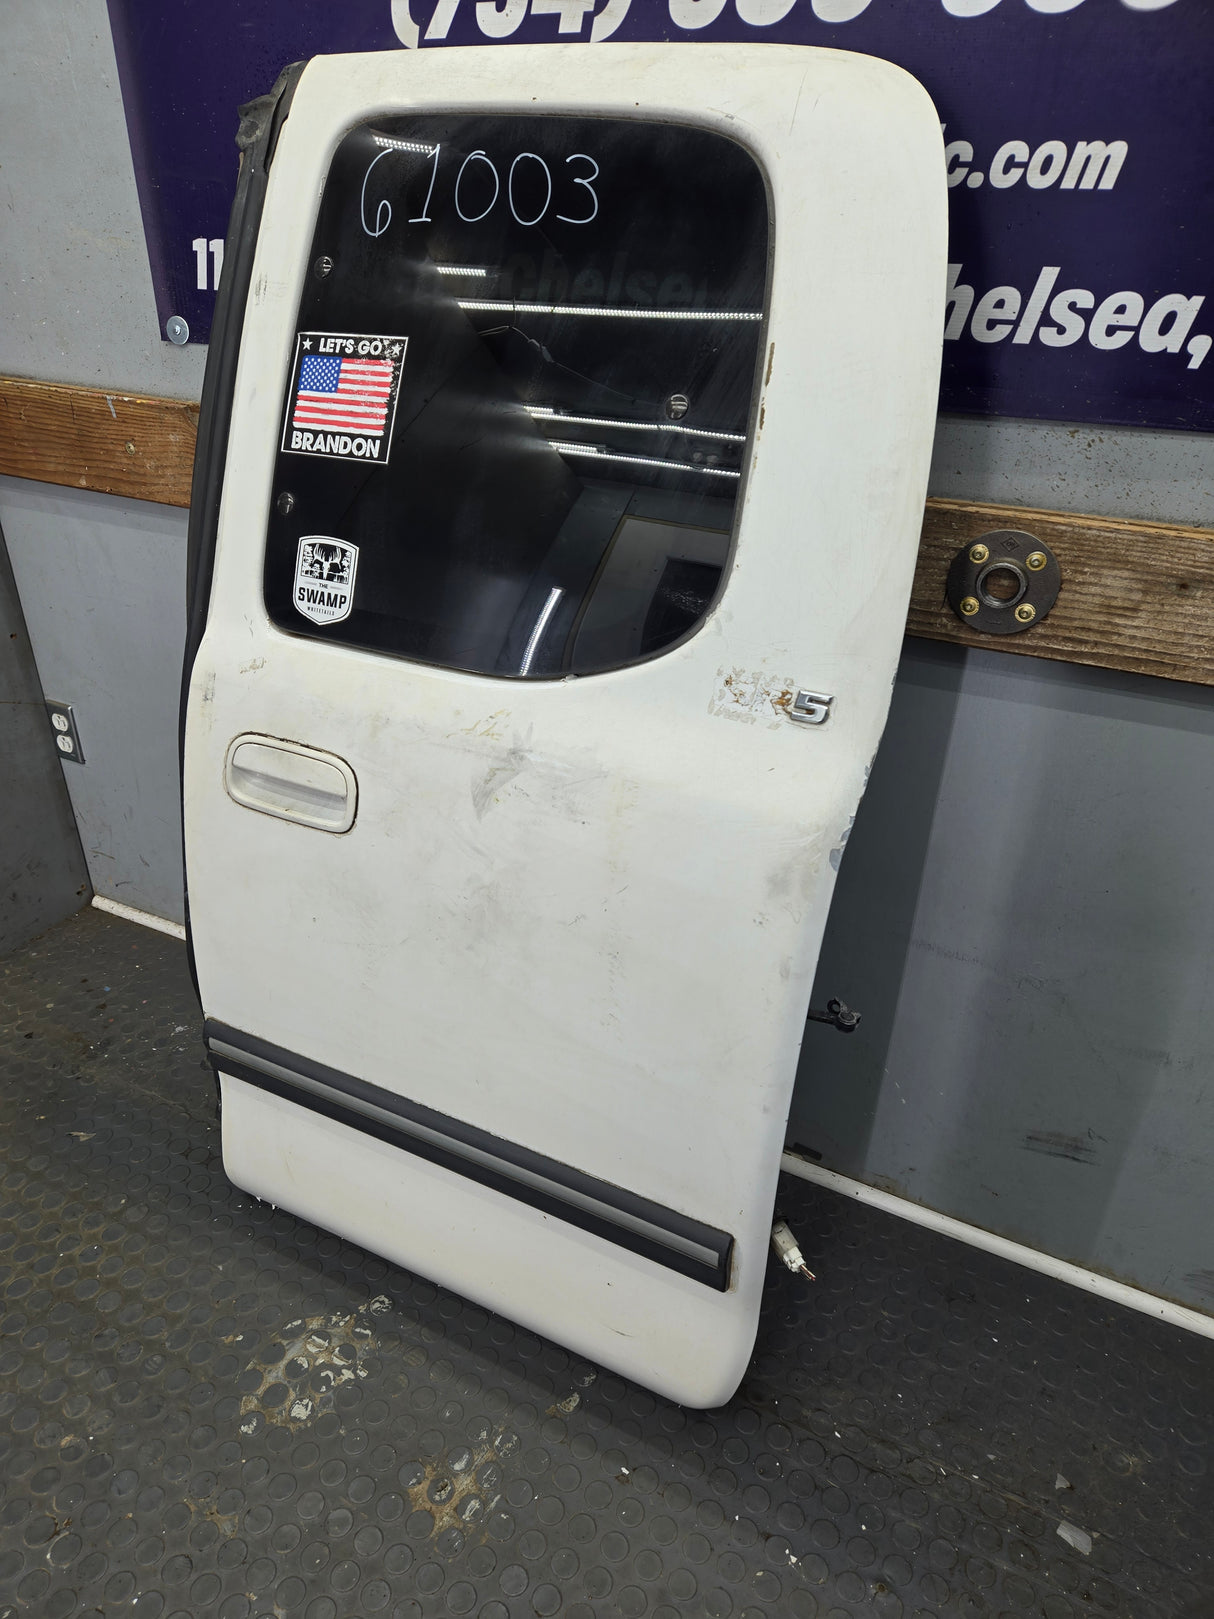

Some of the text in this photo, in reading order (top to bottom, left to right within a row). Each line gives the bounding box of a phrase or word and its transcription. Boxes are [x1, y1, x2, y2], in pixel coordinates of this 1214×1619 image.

[942, 124, 1128, 190] c.com
[361, 144, 600, 237] 61003
[944, 264, 1213, 369] helsea,
[319, 337, 382, 356] LET'S GO
[290, 430, 381, 458] BRANDON
[298, 586, 347, 609] SWAMP
